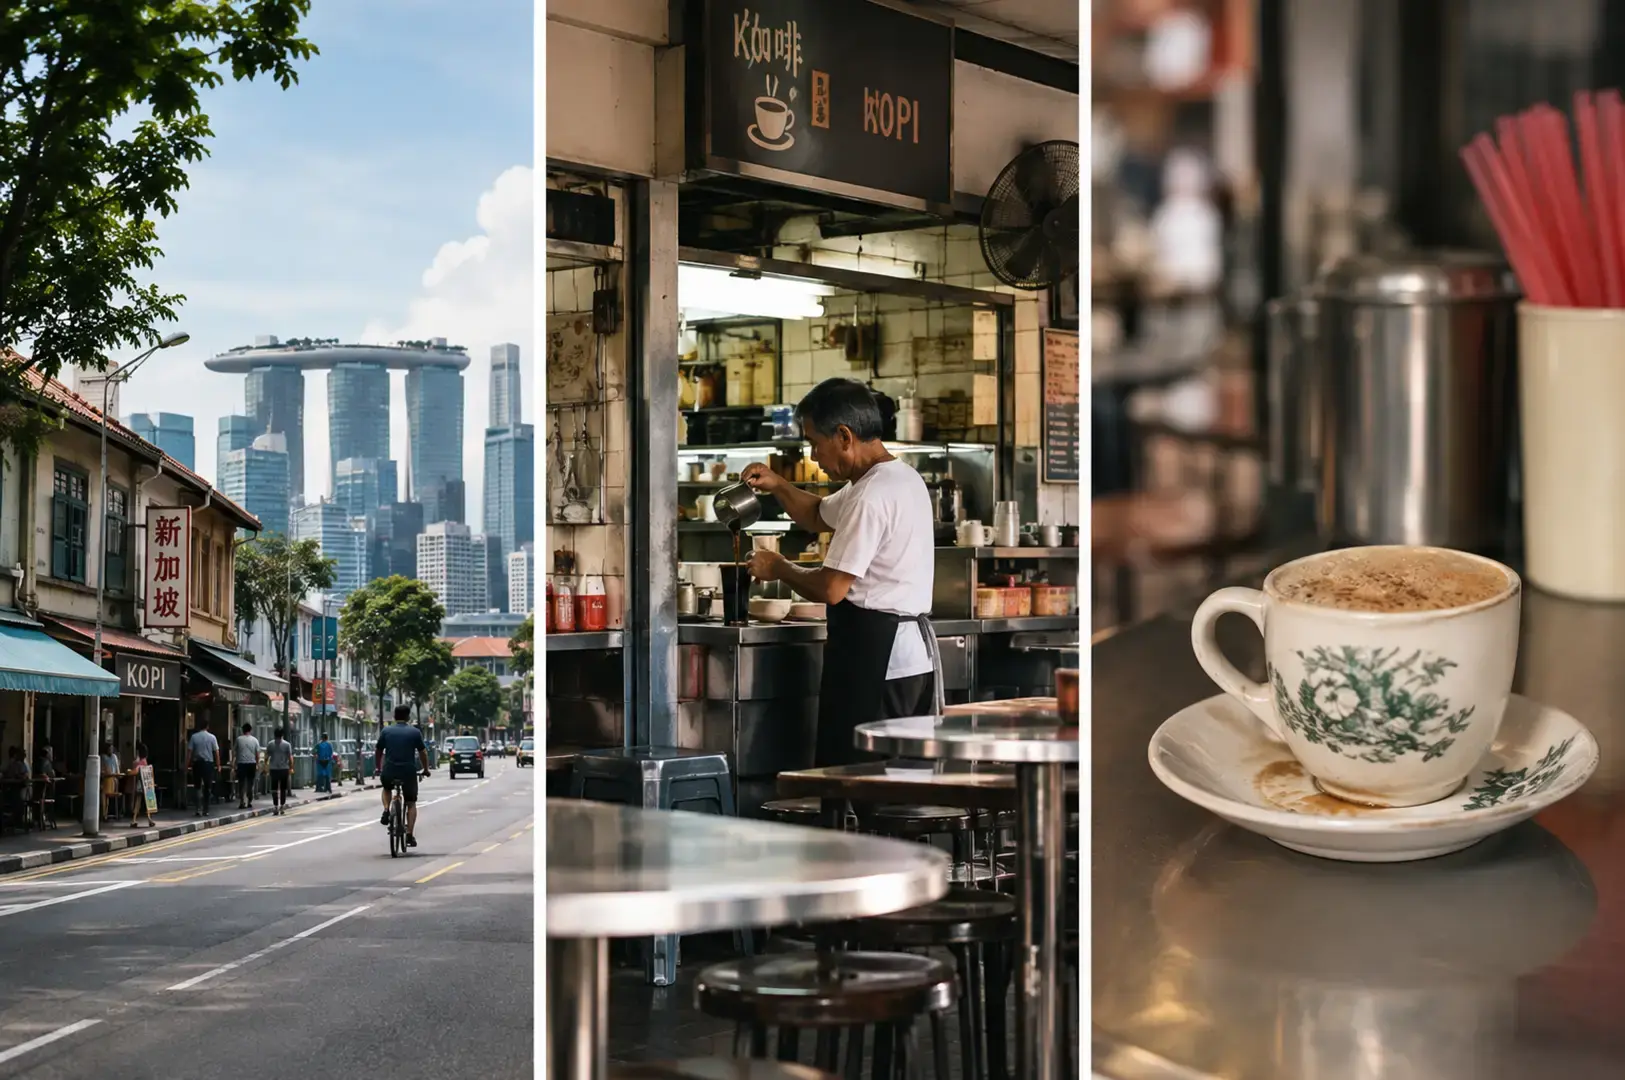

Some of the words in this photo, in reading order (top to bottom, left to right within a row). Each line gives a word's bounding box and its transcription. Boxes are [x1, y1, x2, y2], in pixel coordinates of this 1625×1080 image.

[864, 86, 919, 144] KOPI
[153, 515, 181, 618] 新加坡
[127, 662, 165, 690] KOPI
